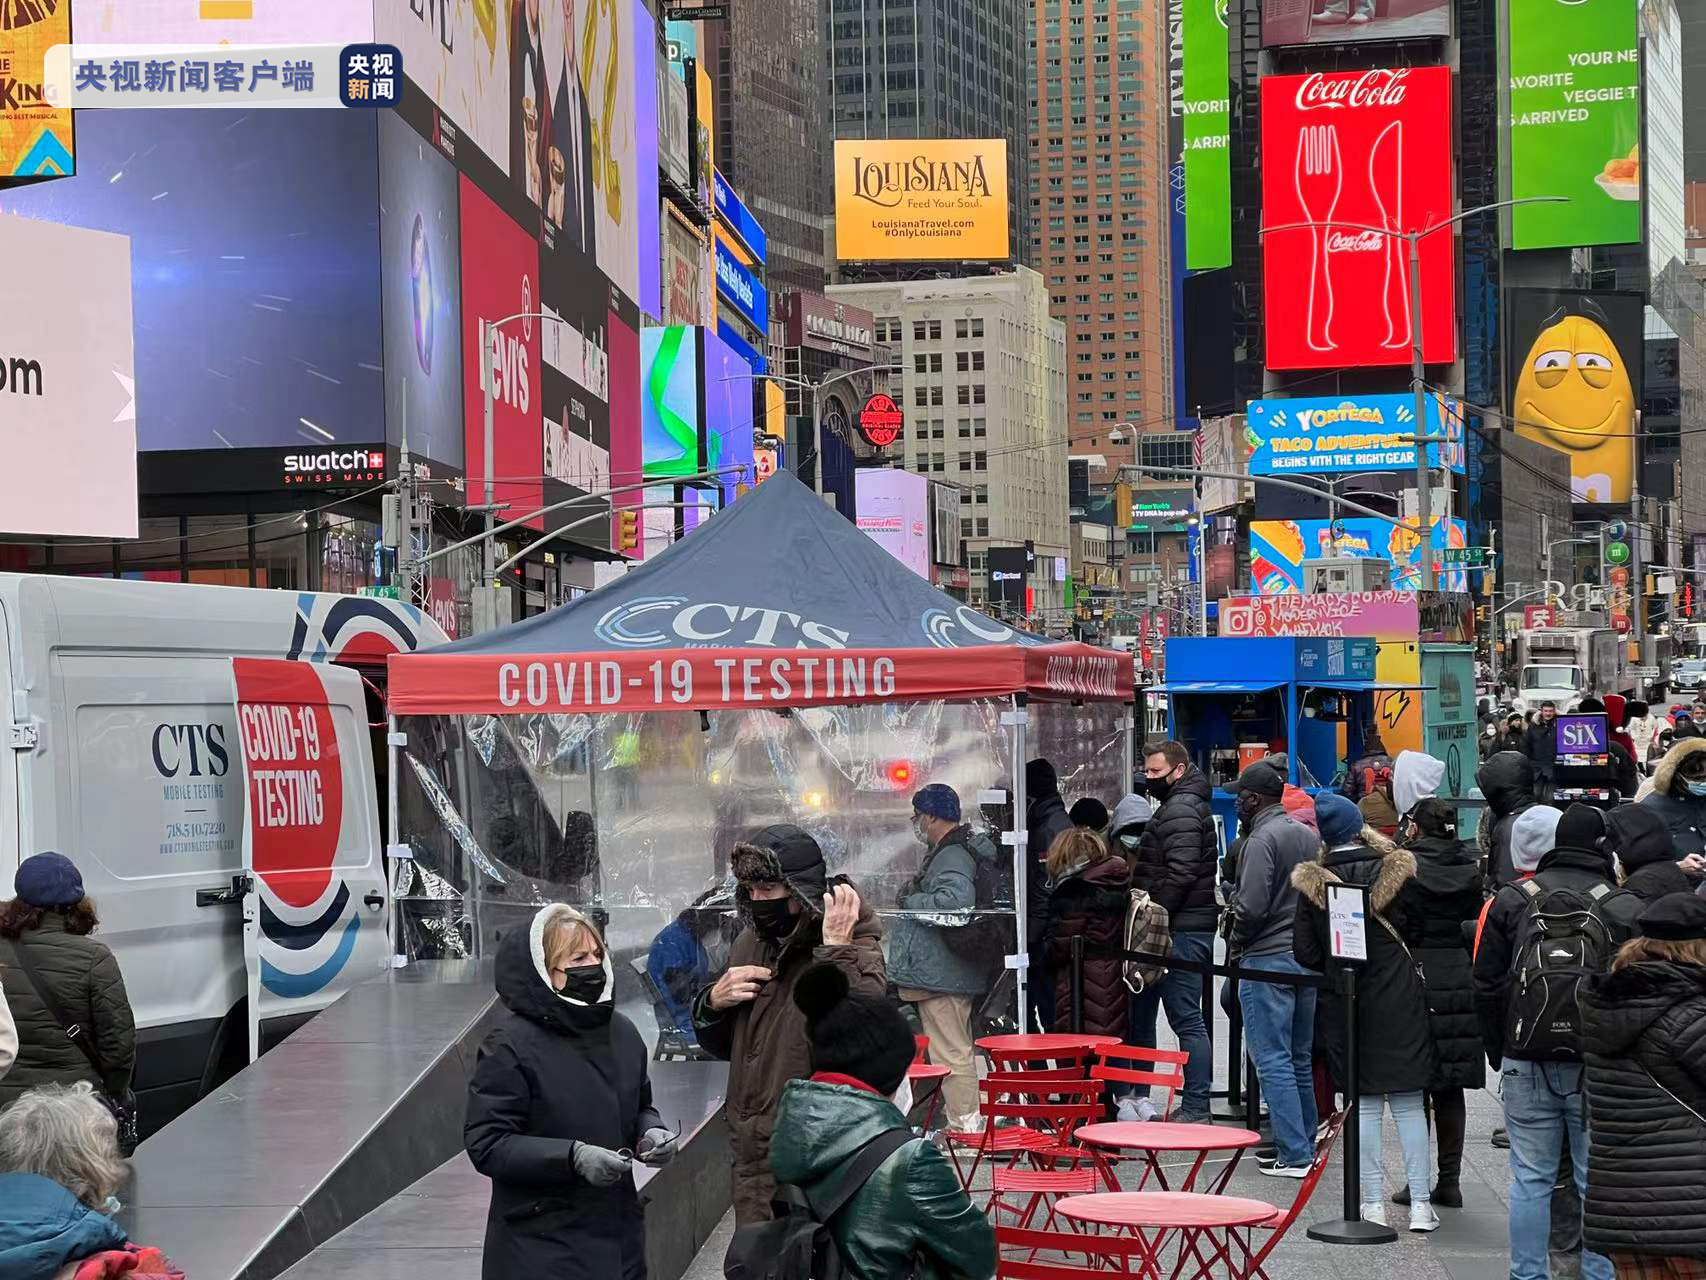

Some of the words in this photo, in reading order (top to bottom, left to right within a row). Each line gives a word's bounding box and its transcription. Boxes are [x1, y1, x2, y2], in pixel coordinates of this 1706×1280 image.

[1567, 51, 1613, 67] YOUR
[1295, 67, 1411, 110] Coca-Cola
[1563, 86, 1625, 103] VEGGIE
[1519, 108, 1590, 126] ARRIVED
[853, 154, 993, 208] LOUISIANA
[908, 198, 930, 208] Feed
[933, 198, 956, 208] Your
[872, 219, 975, 229] LouisianaTravel.com
[885, 228, 962, 239] #OnlyLouisiana
[1328, 230, 1383, 252] Coca-Cola
[1270, 436, 1313, 453] TACO
[1315, 432, 1416, 452] ADVENTURE
[284, 449, 369, 472] swatch
[1271, 457, 1308, 468] BEGINS
[1333, 453, 1354, 466] THE
[1354, 452, 1387, 465] RIGHT
[1386, 451, 1416, 464] GEAR
[284, 474, 332, 483] SWISS
[343, 472, 384, 481] MADE
[1446, 551, 1455, 561] W
[1459, 550, 1471, 561] 45
[499, 658, 694, 706] COVID-19
[714, 656, 896, 702] TESTING
[1045, 655, 1086, 695] COVID-19
[1087, 655, 1118, 696] TESTING
[241, 703, 320, 761] COVID-19
[152, 723, 229, 778] CTS
[163, 784, 192, 801] MOBILE
[193, 784, 225, 800] TESTING
[253, 769, 323, 827] TESTING
